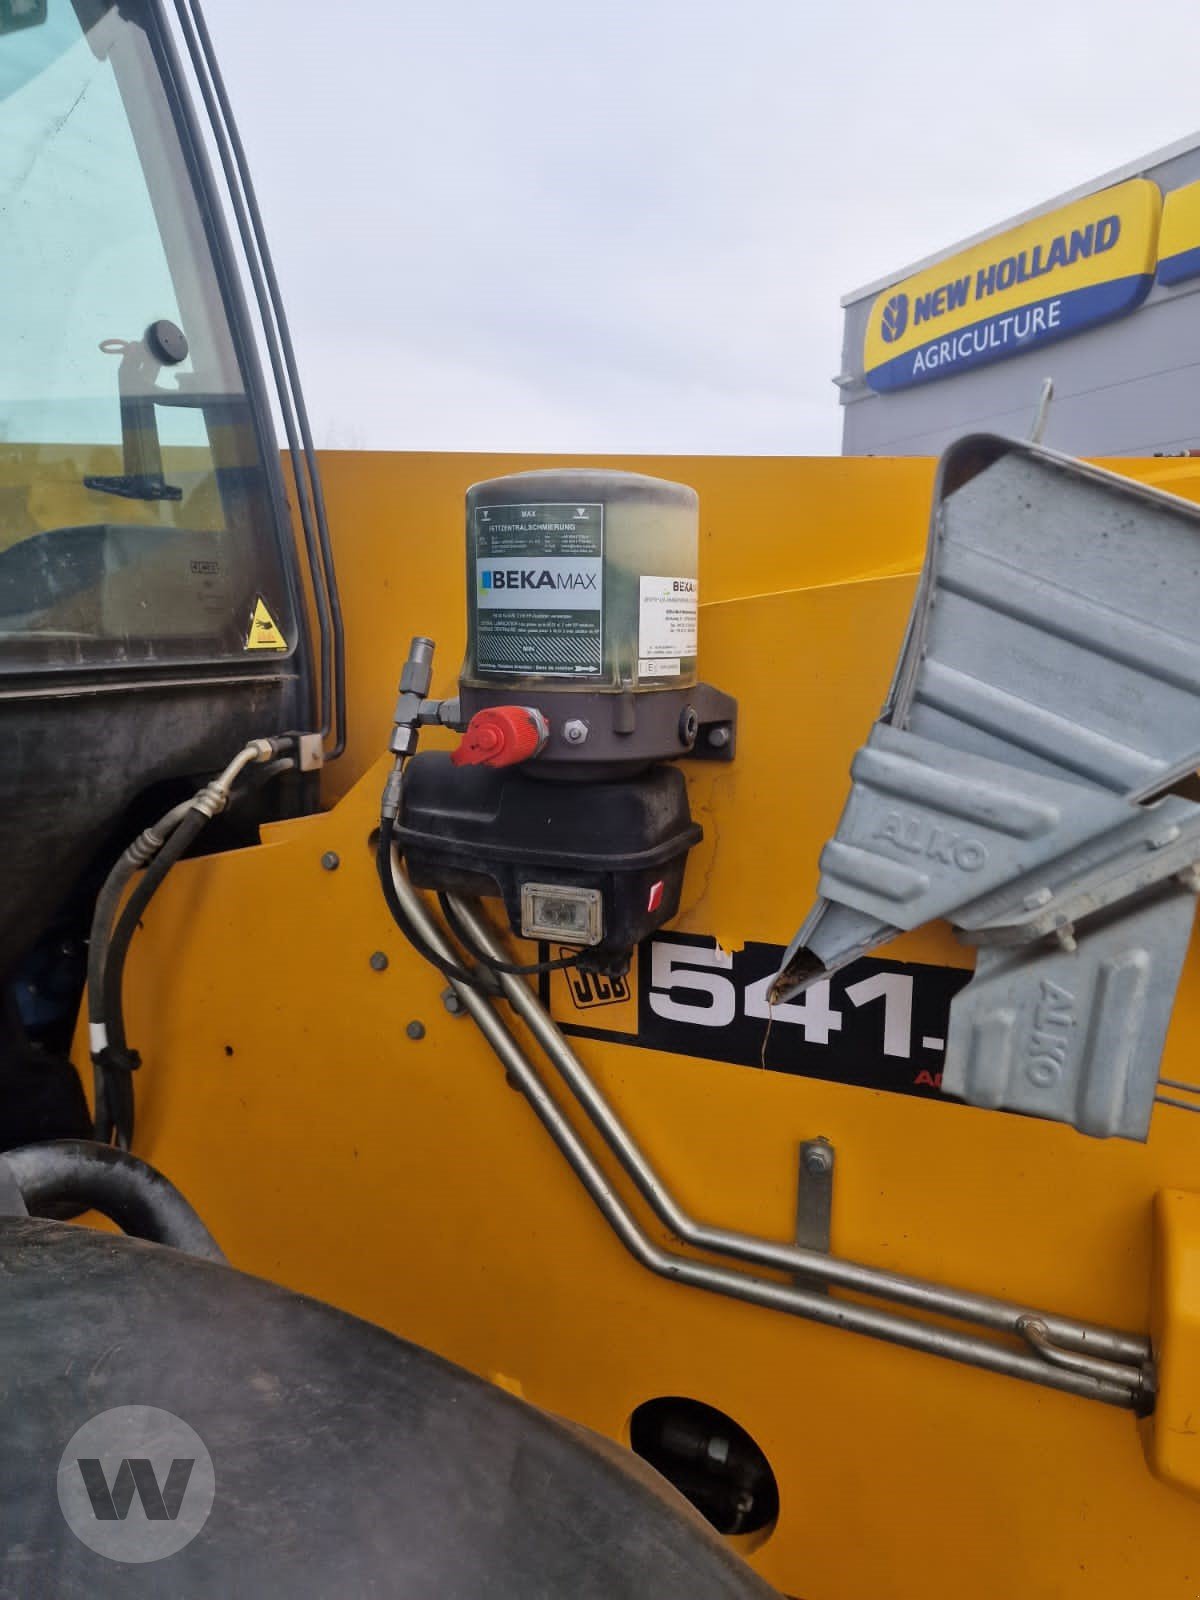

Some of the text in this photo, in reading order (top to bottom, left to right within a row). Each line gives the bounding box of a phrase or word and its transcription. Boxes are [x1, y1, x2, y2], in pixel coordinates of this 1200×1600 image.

[914, 214, 1121, 325] NEW HOLLAND
[912, 299, 1062, 375] AGRICULTURE
[521, 510, 537, 518] MAX
[492, 570, 597, 590] BEKAMAX
